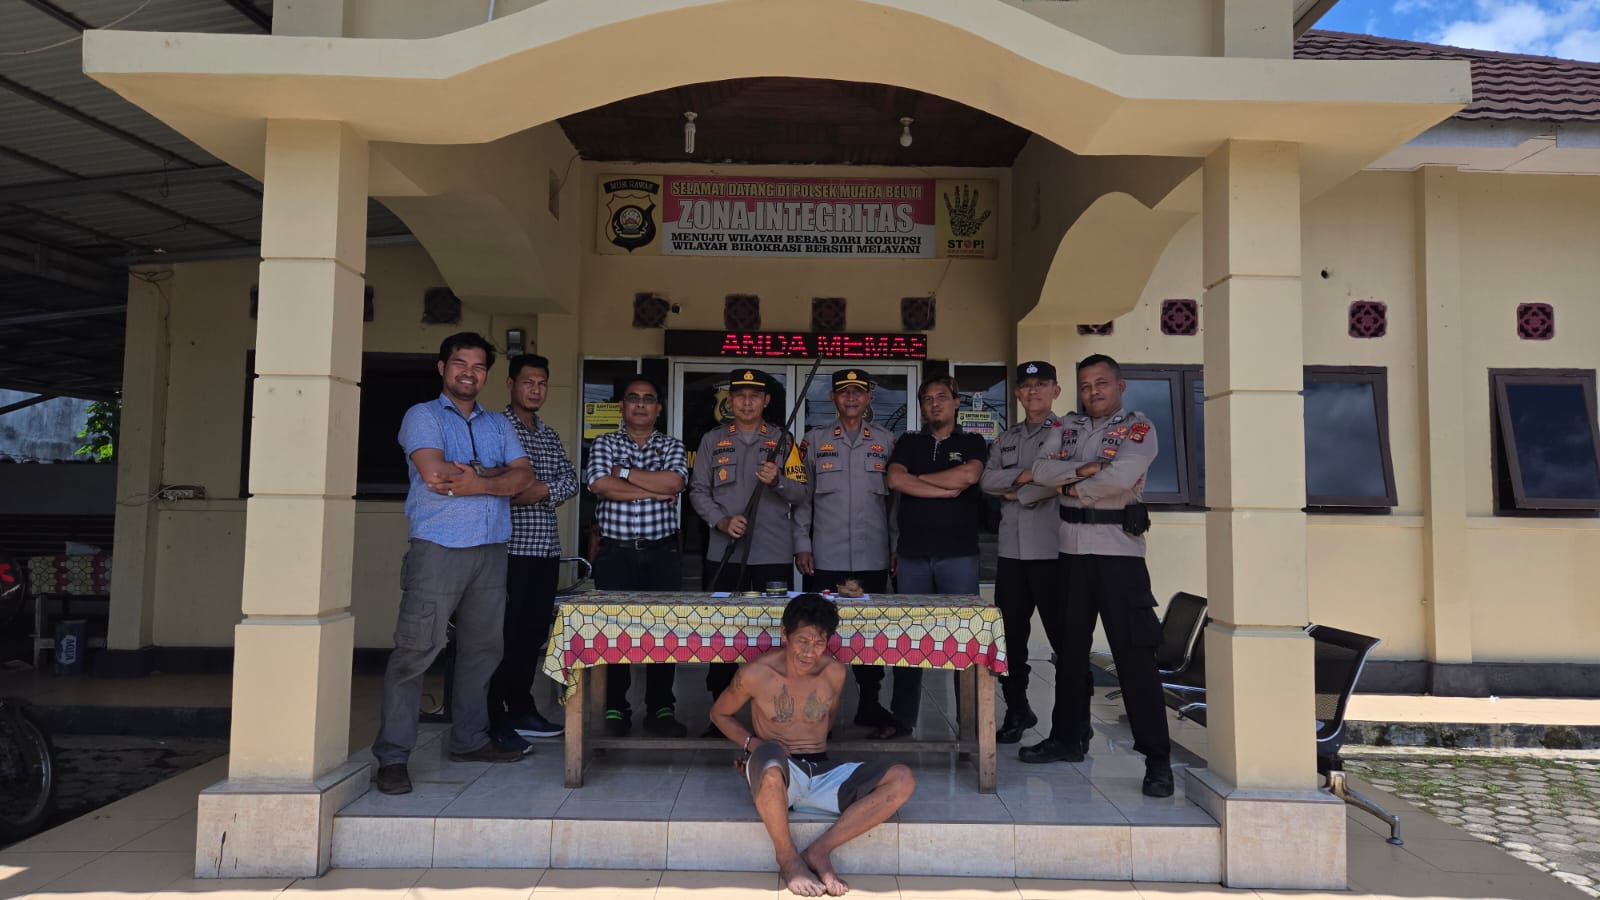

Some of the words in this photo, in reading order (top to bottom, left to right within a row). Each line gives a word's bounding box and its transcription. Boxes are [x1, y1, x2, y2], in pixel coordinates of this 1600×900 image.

[671, 181, 725, 196] SELAMAT
[728, 183, 774, 197] DATANG
[778, 184, 790, 197] DI
[792, 184, 838, 199] POLSEK
[839, 184, 883, 199] MUARA
[887, 185, 922, 200] BELITI
[677, 199, 750, 230] ZONA
[754, 202, 914, 233] INTEGRITAS
[671, 232, 724, 242] MENUJU
[728, 234, 783, 243] WILAYAH
[786, 234, 827, 244] BEBAS
[831, 235, 861, 244] DARI
[865, 235, 921, 245] KORUPSI
[947, 239, 984, 249] STOP!
[673, 242, 727, 251] WILAYAH
[730, 243, 803, 252] BIROKRASI
[805, 244, 853, 253] BERSIH
[856, 244, 921, 254] MELAYANI
[720, 334, 807, 356] ANDA
[1102, 438, 1120, 447] POL
[64, 638, 75, 661] AQUA
